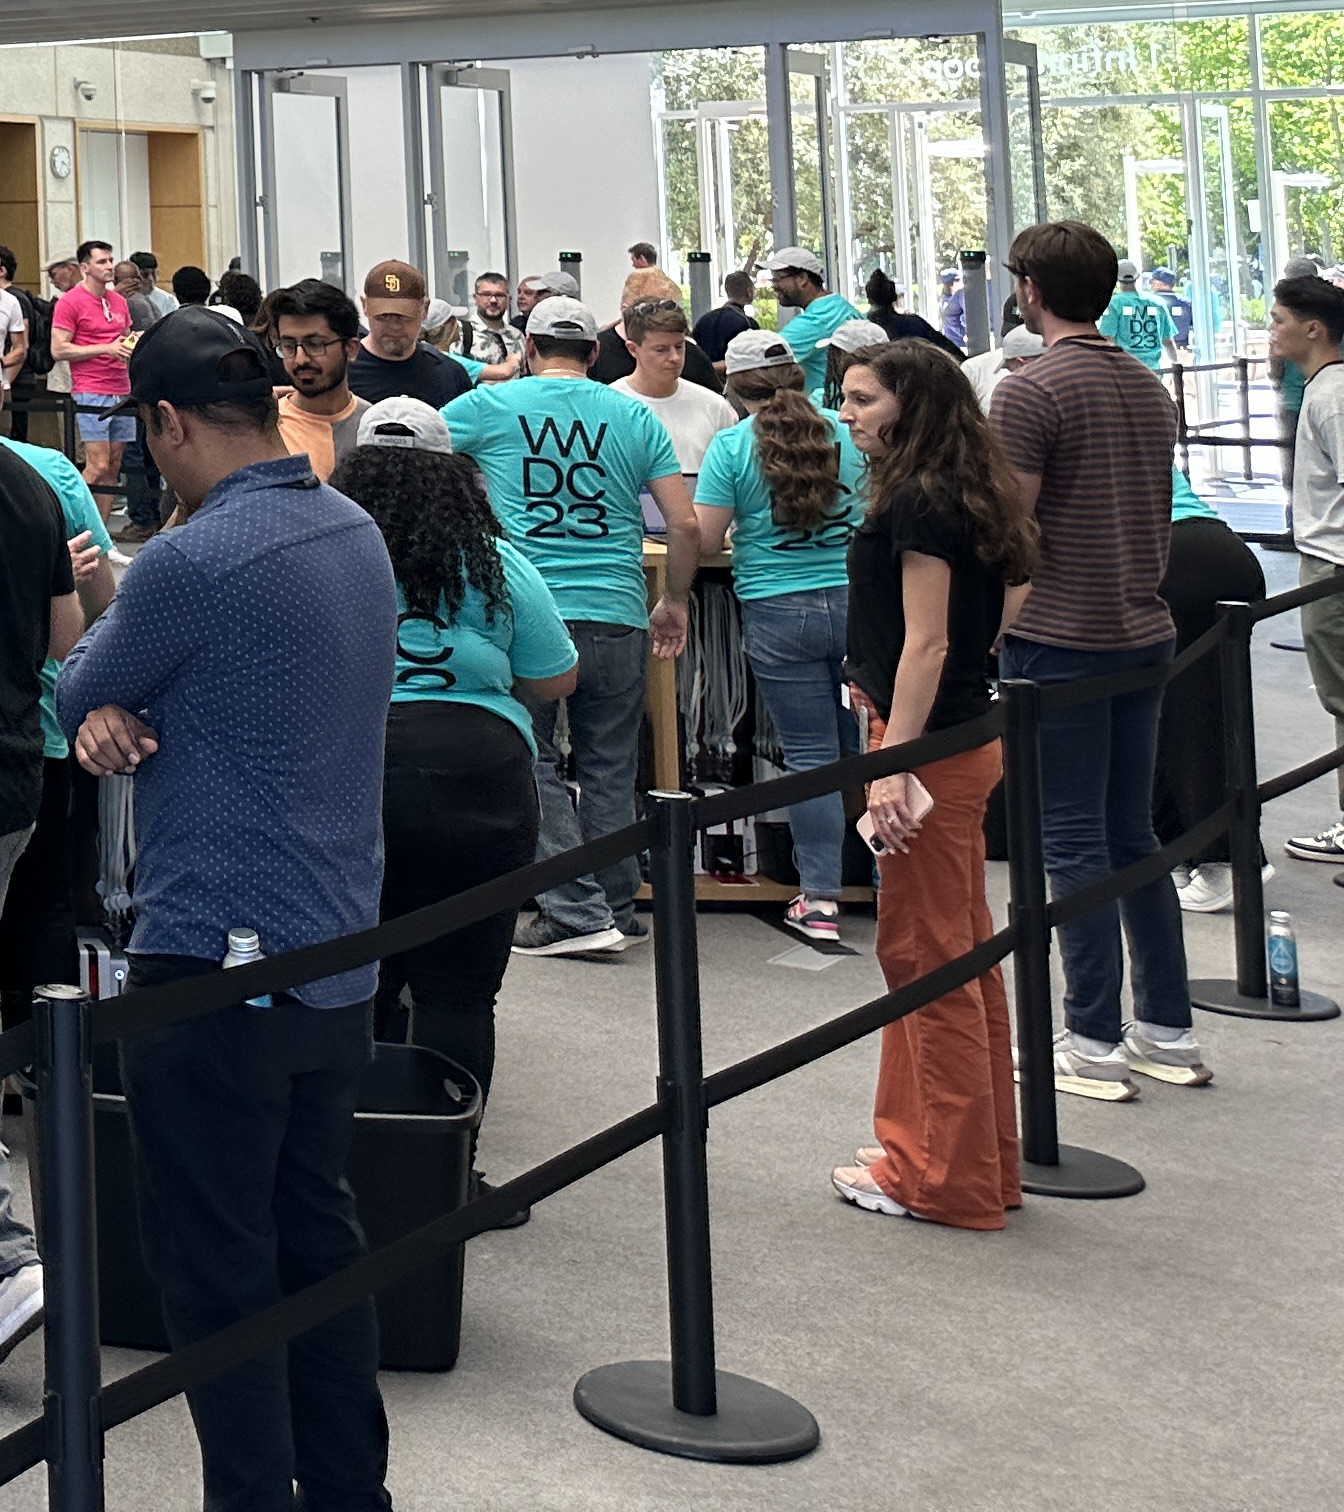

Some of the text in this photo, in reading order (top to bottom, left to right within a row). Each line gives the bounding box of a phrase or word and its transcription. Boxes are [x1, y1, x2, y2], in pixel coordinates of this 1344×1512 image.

[385, 274, 401, 292] SD
[1129, 334, 1158, 349] 23
[522, 457, 608, 502] DC
[524, 500, 610, 539] 23
